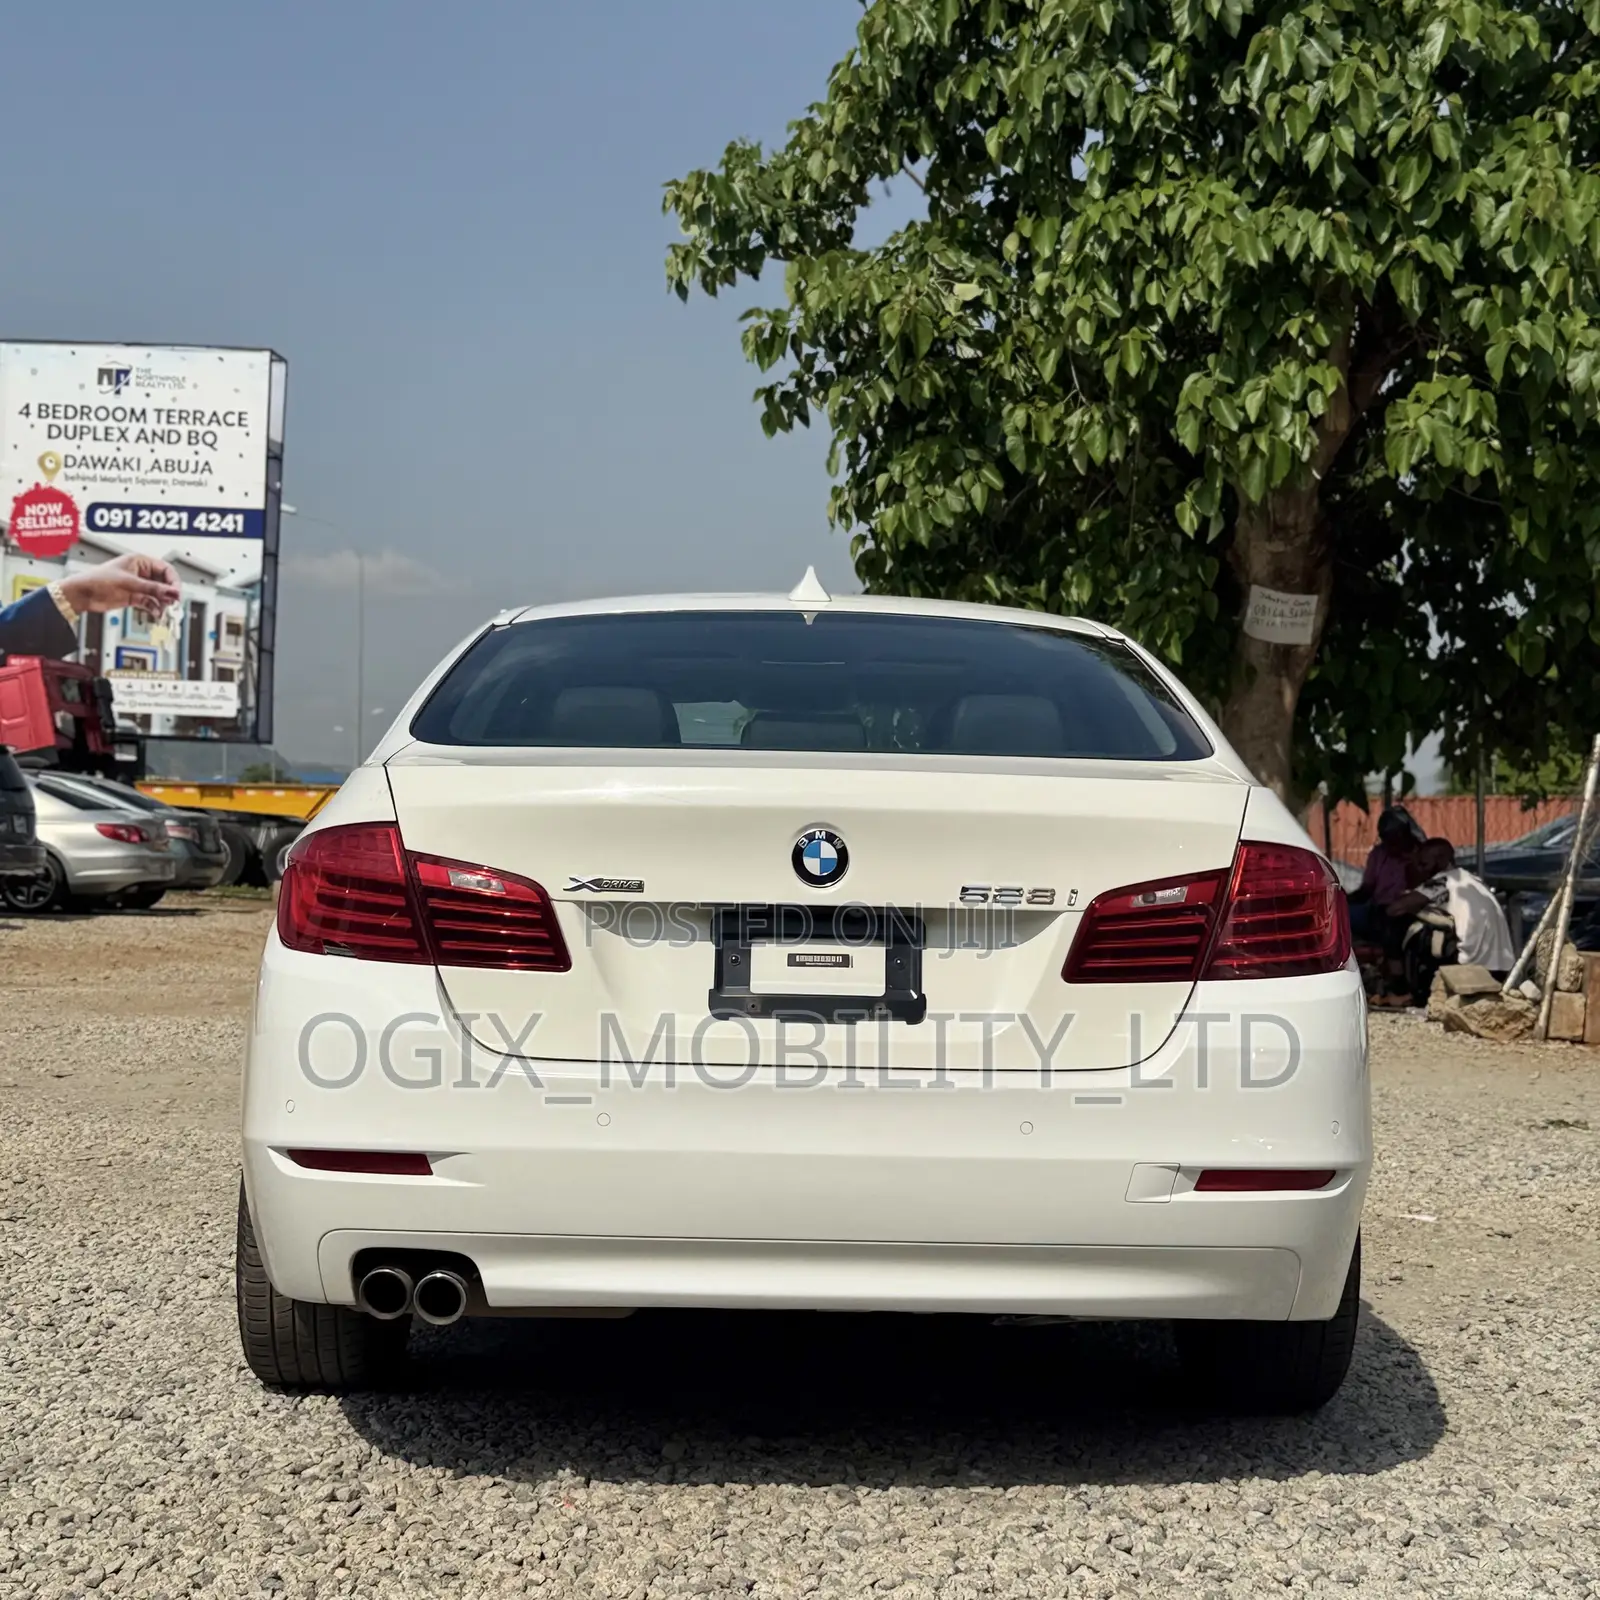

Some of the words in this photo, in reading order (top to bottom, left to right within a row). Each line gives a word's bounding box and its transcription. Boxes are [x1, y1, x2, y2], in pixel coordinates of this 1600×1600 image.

[18, 403, 31, 419] 4
[37, 403, 147, 424] BEDROOM
[153, 408, 248, 427] TERRACE
[47, 424, 130, 443] DUPLEX
[134, 428, 181, 446] AND
[187, 430, 218, 451] BQ
[63, 454, 141, 472] DAWAKI
[64, 473, 97, 482] behind
[25, 502, 63, 517] NOW
[16, 514, 73, 530] SELLING
[94, 508, 132, 528] 091
[136, 510, 189, 530] 2021
[193, 513, 244, 532] 4241
[798, 830, 845, 849] BMW
